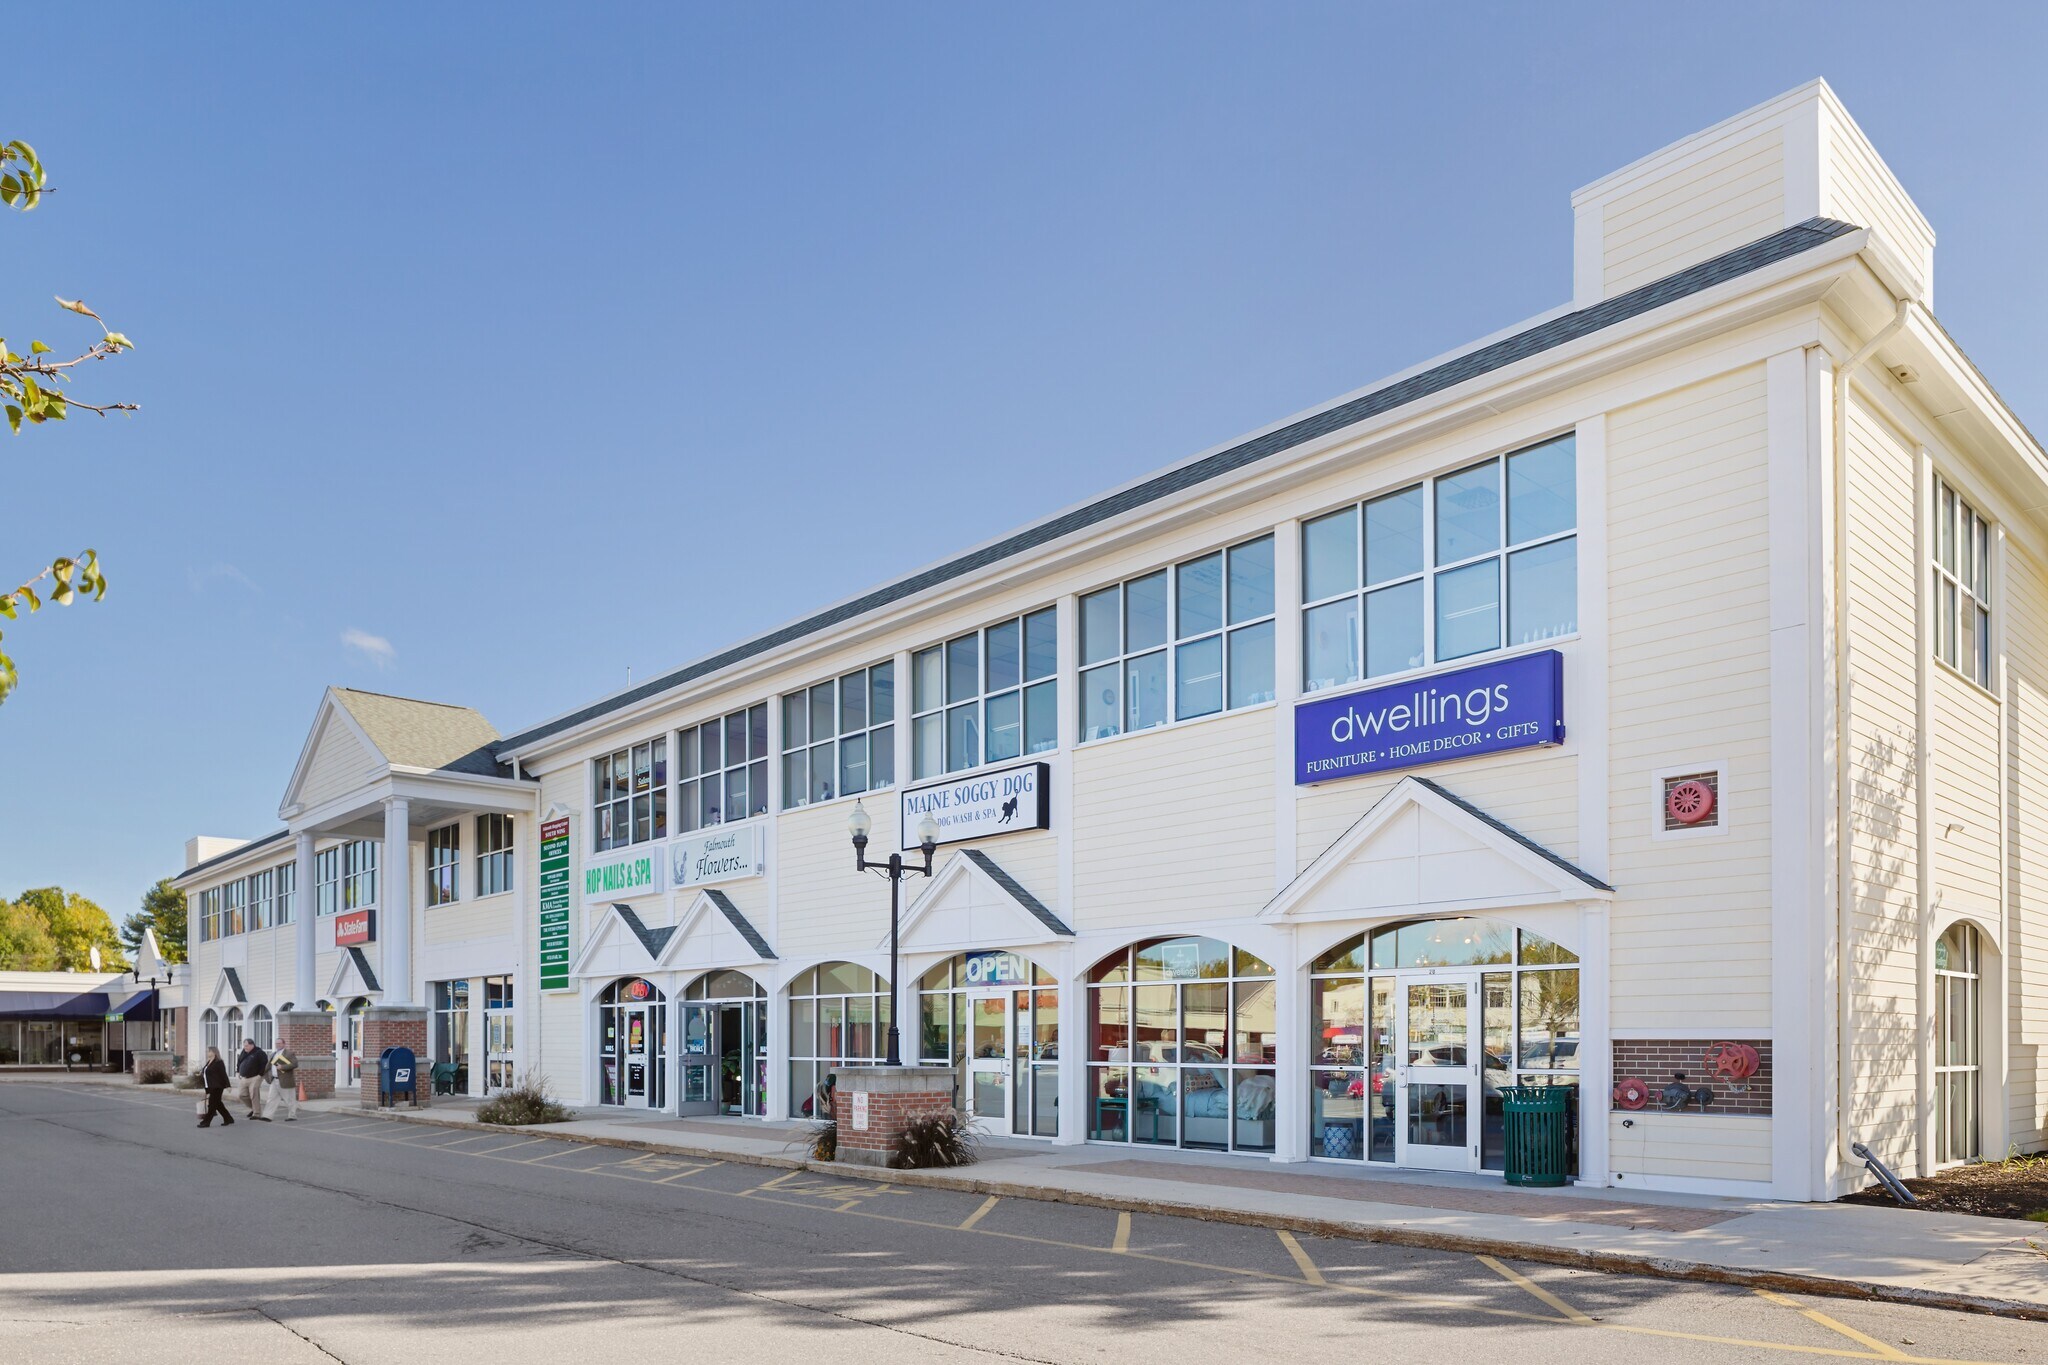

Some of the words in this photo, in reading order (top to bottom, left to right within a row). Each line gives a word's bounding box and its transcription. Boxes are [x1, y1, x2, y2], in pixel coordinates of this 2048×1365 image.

[1331, 683, 1509, 743] dwellings
[1306, 750, 1376, 773] FURNITURE
[1389, 741, 1431, 758] HOME
[1433, 731, 1482, 750] DECOR
[1496, 721, 1539, 740] GIFTS
[907, 790, 950, 815] MAINE
[954, 780, 998, 806] SOGGY
[1003, 772, 1033, 797] DOG
[937, 816, 951, 827] DOG
[952, 812, 973, 824] WASH
[974, 811, 981, 821] &
[982, 808, 997, 820] SPA
[704, 833, 735, 855] Falmouth
[586, 868, 602, 895] HOP
[603, 863, 625, 892] NAILS
[627, 864, 633, 888] &
[635, 857, 652, 886] SPA
[966, 954, 1026, 982] OPEN
